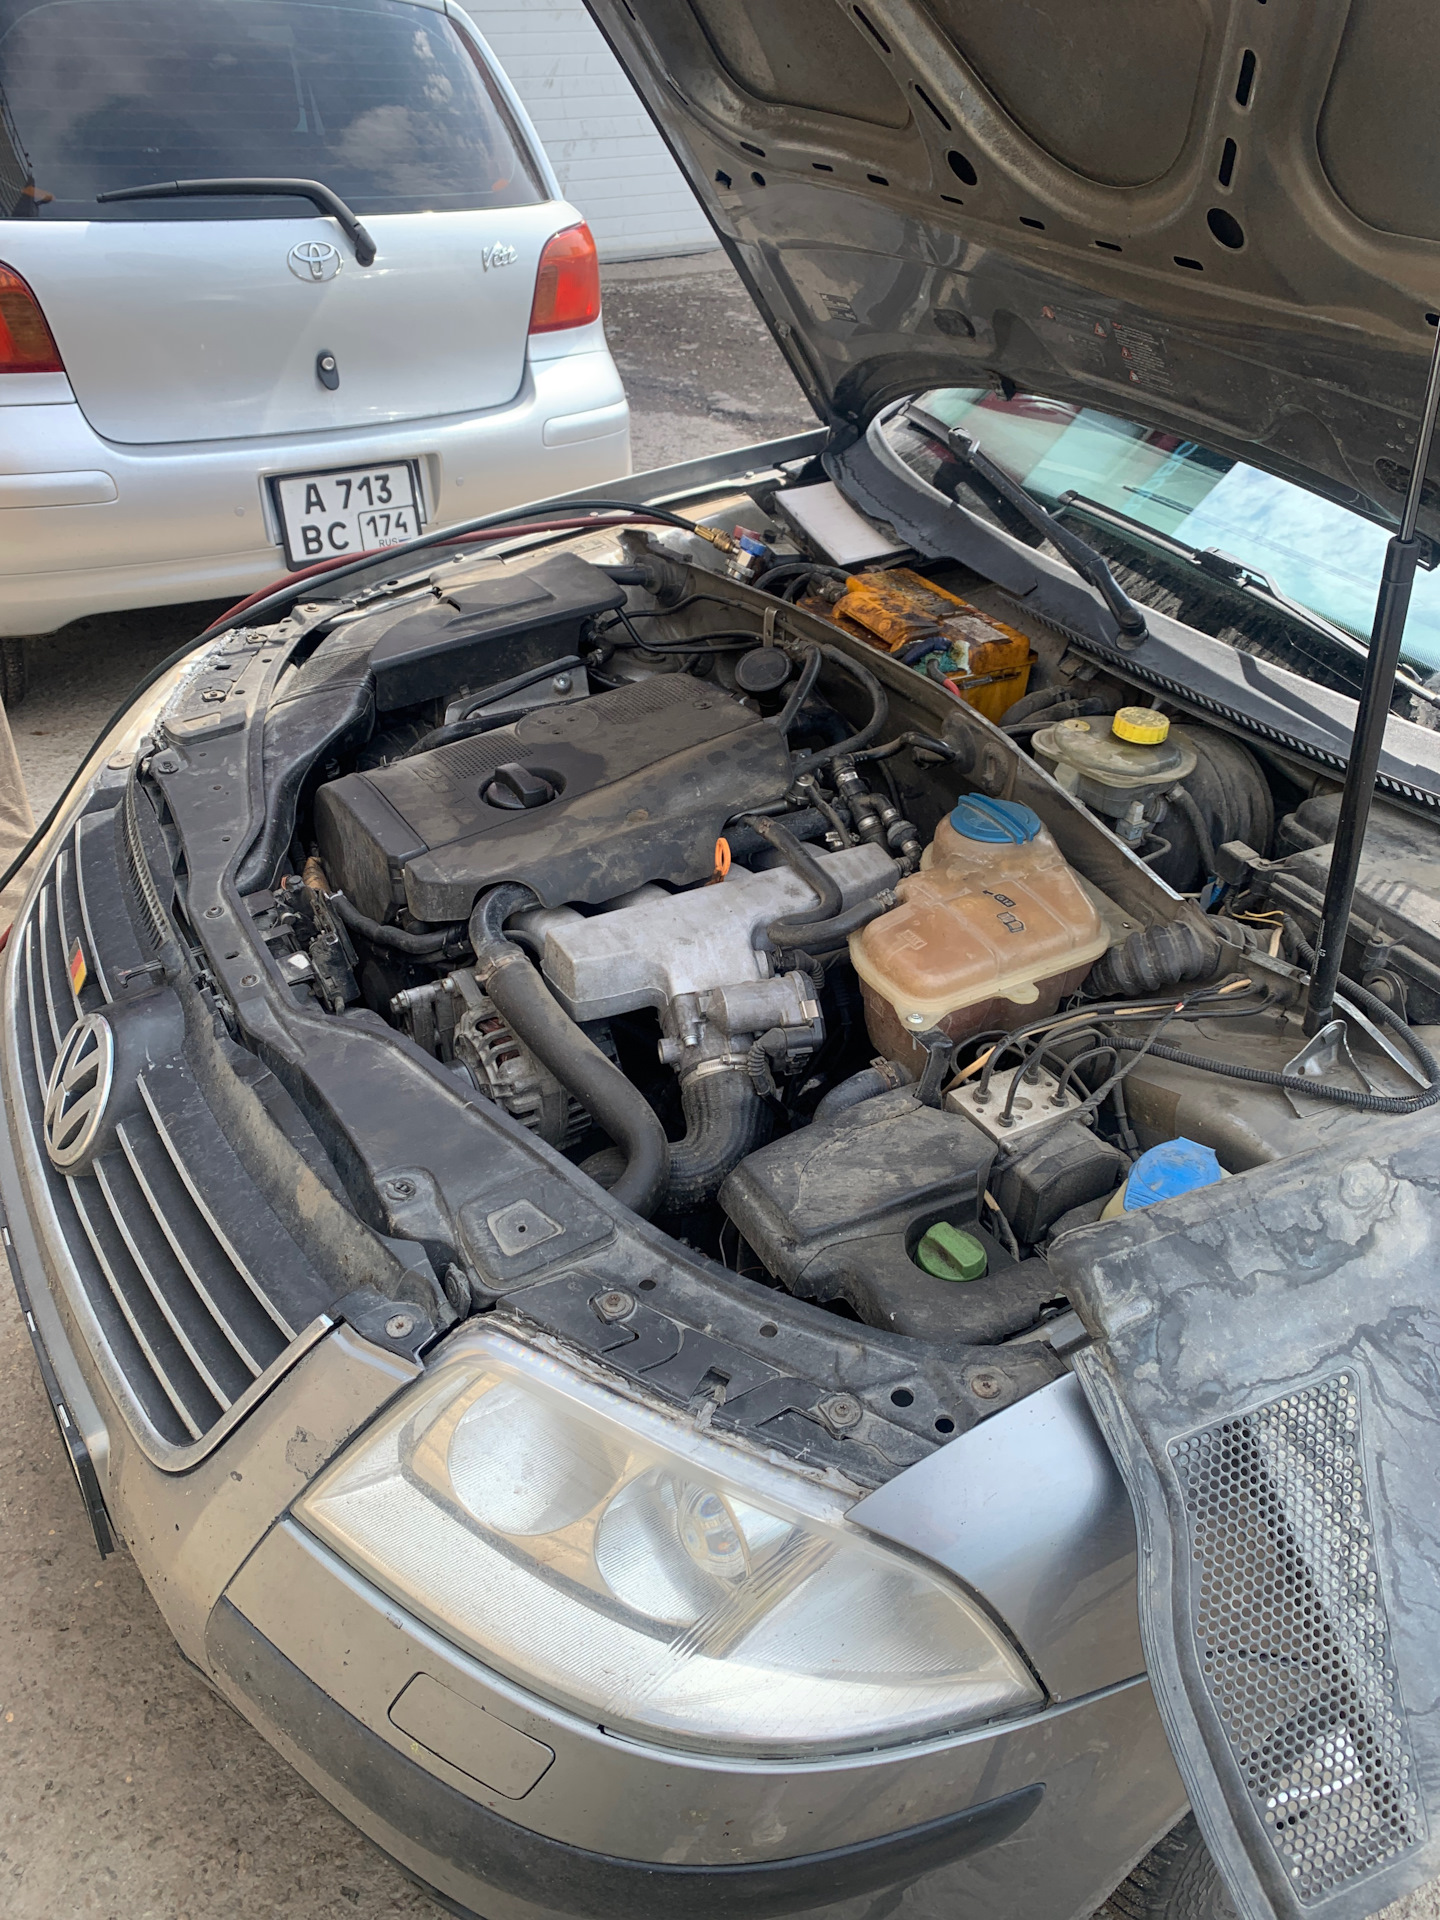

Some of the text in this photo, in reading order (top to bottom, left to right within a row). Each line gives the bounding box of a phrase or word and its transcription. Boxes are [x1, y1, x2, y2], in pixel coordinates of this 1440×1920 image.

[305, 474, 392, 514] A 713
[301, 512, 408, 555] BC 174
[378, 537, 398, 547] RUS
